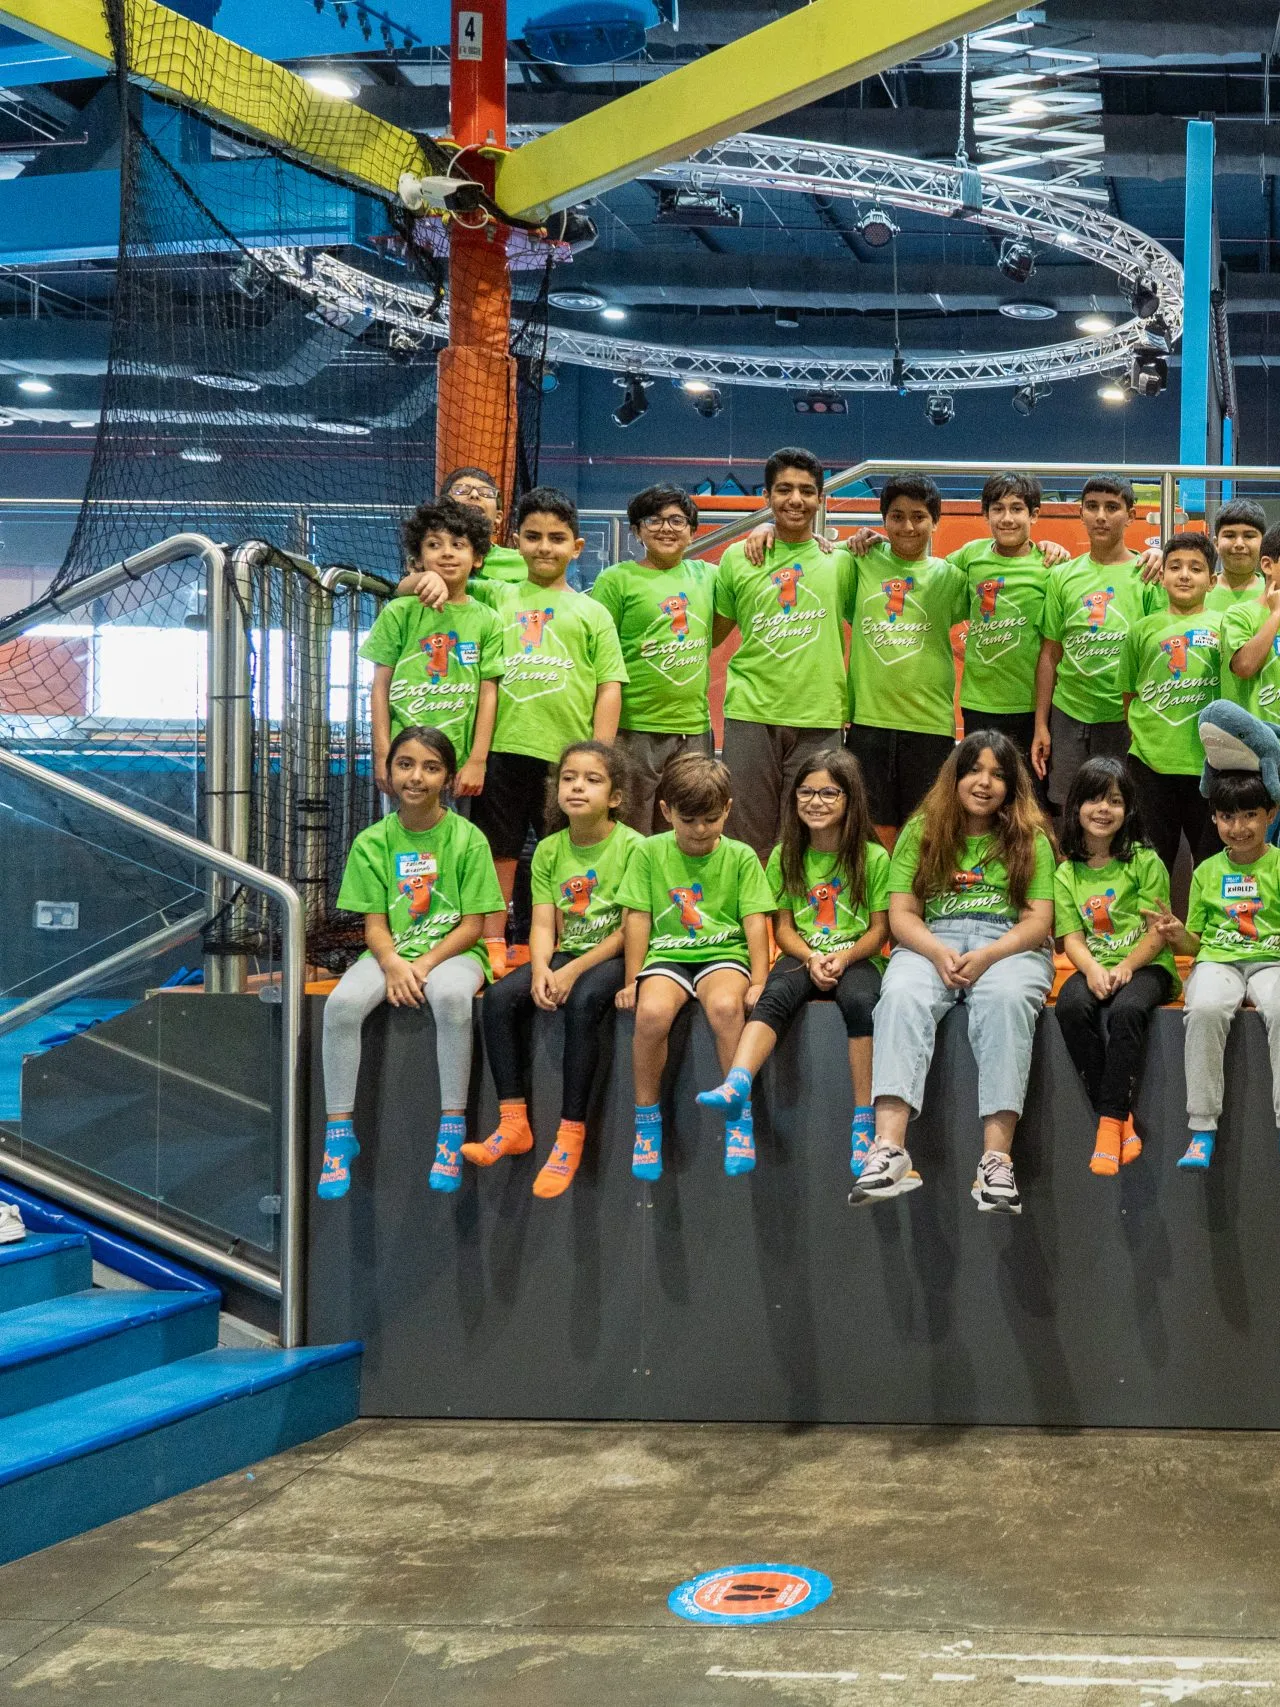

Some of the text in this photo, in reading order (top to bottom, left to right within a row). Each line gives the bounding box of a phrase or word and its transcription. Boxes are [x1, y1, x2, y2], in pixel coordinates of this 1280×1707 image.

[465, 17, 475, 41] 4
[751, 607, 827, 632] Extreme
[861, 617, 932, 635] Extreme
[765, 624, 813, 643] Camp
[873, 634, 918, 648] Camp
[1065, 631, 1127, 649] Extrem
[641, 637, 708, 657] Extrem
[1075, 645, 1120, 661] Camp
[504, 652, 575, 669] xtreme
[502, 668, 559, 685] Camp
[389, 680, 475, 701] Extrem
[1141, 675, 1220, 703] Extreme
[408, 697, 465, 714] Camp
[1156, 691, 1206, 711] Camp
[941, 893, 1004, 915] Camp
